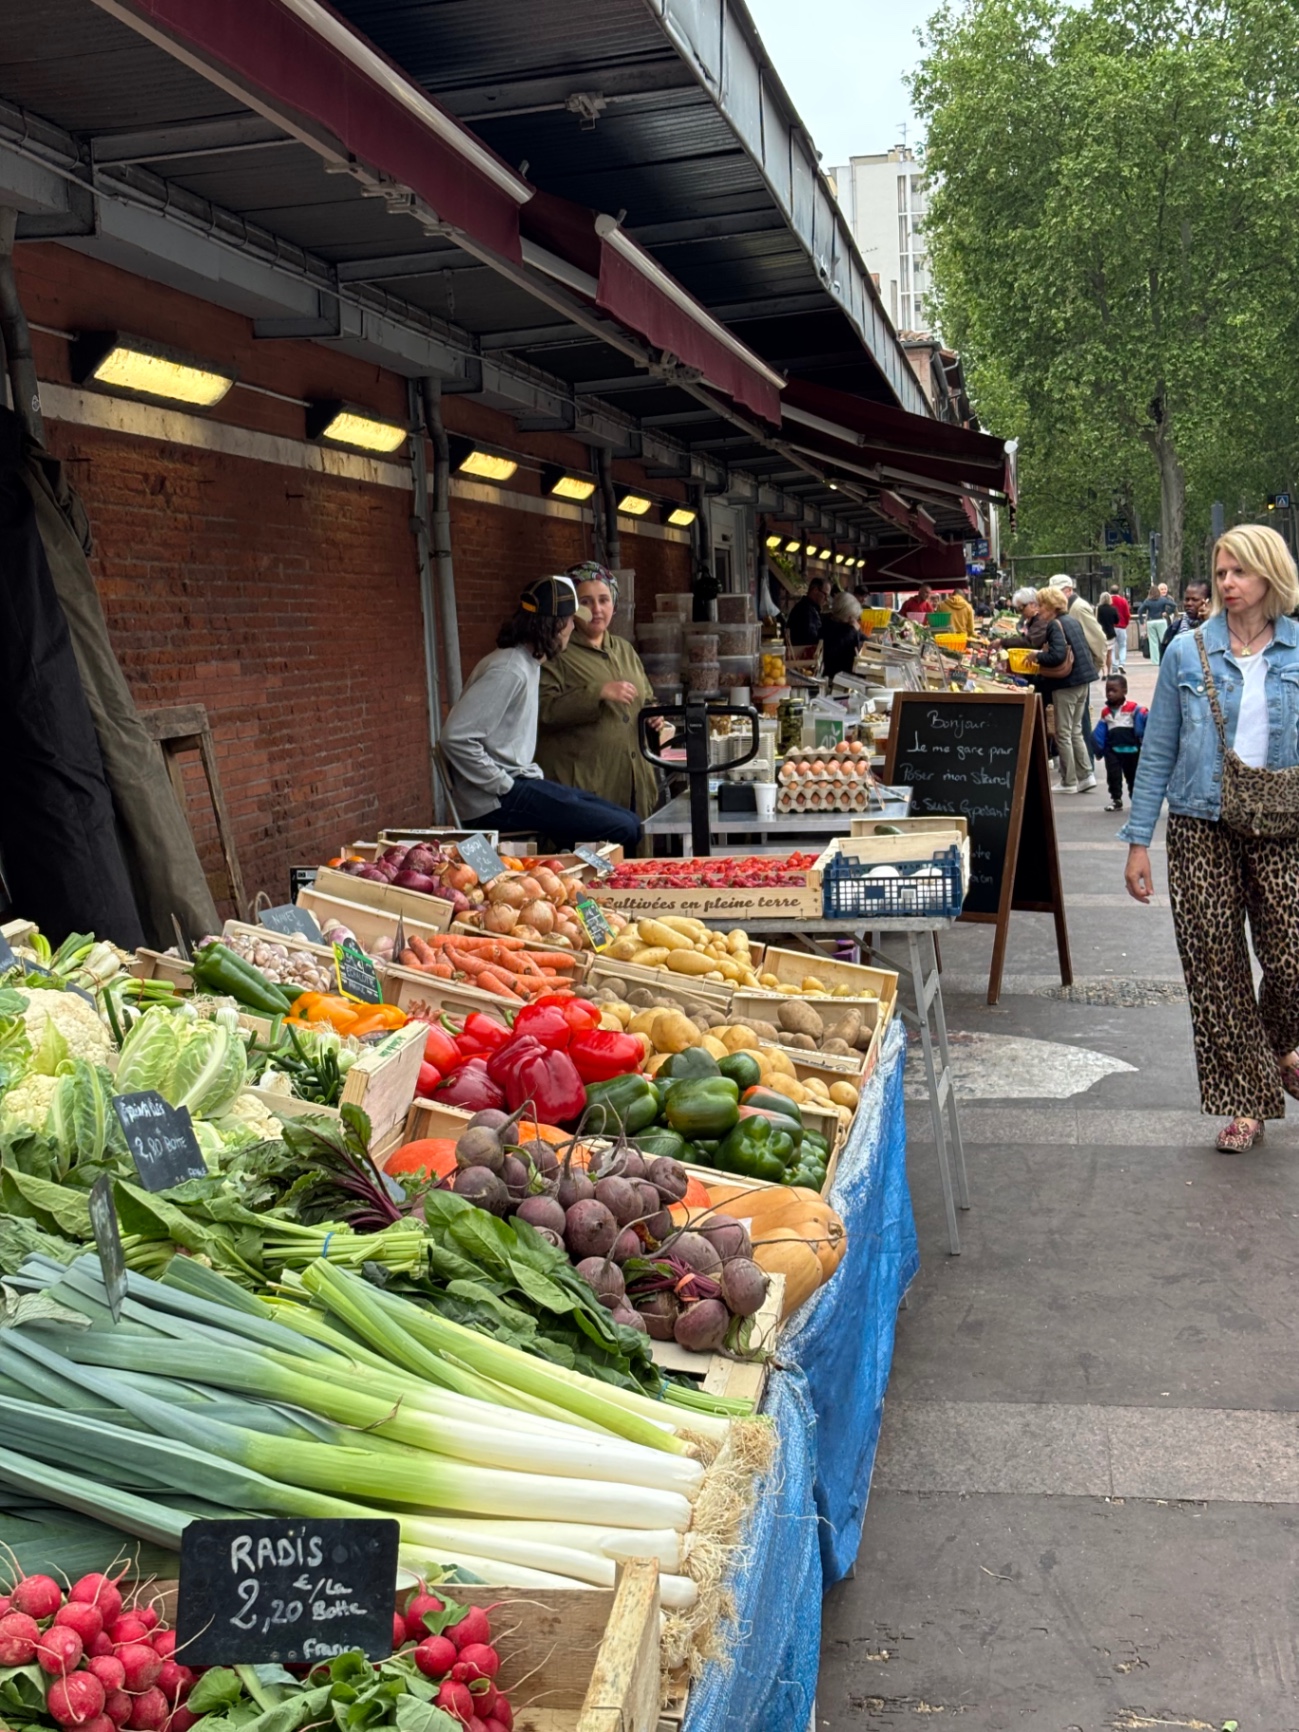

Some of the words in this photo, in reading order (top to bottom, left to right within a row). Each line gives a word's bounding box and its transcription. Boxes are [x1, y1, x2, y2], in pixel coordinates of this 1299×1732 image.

[680, 899, 701, 910] en
[704, 897, 755, 912] pleine
[758, 896, 801, 908] terre
[229, 1578, 304, 1635] 2,20
